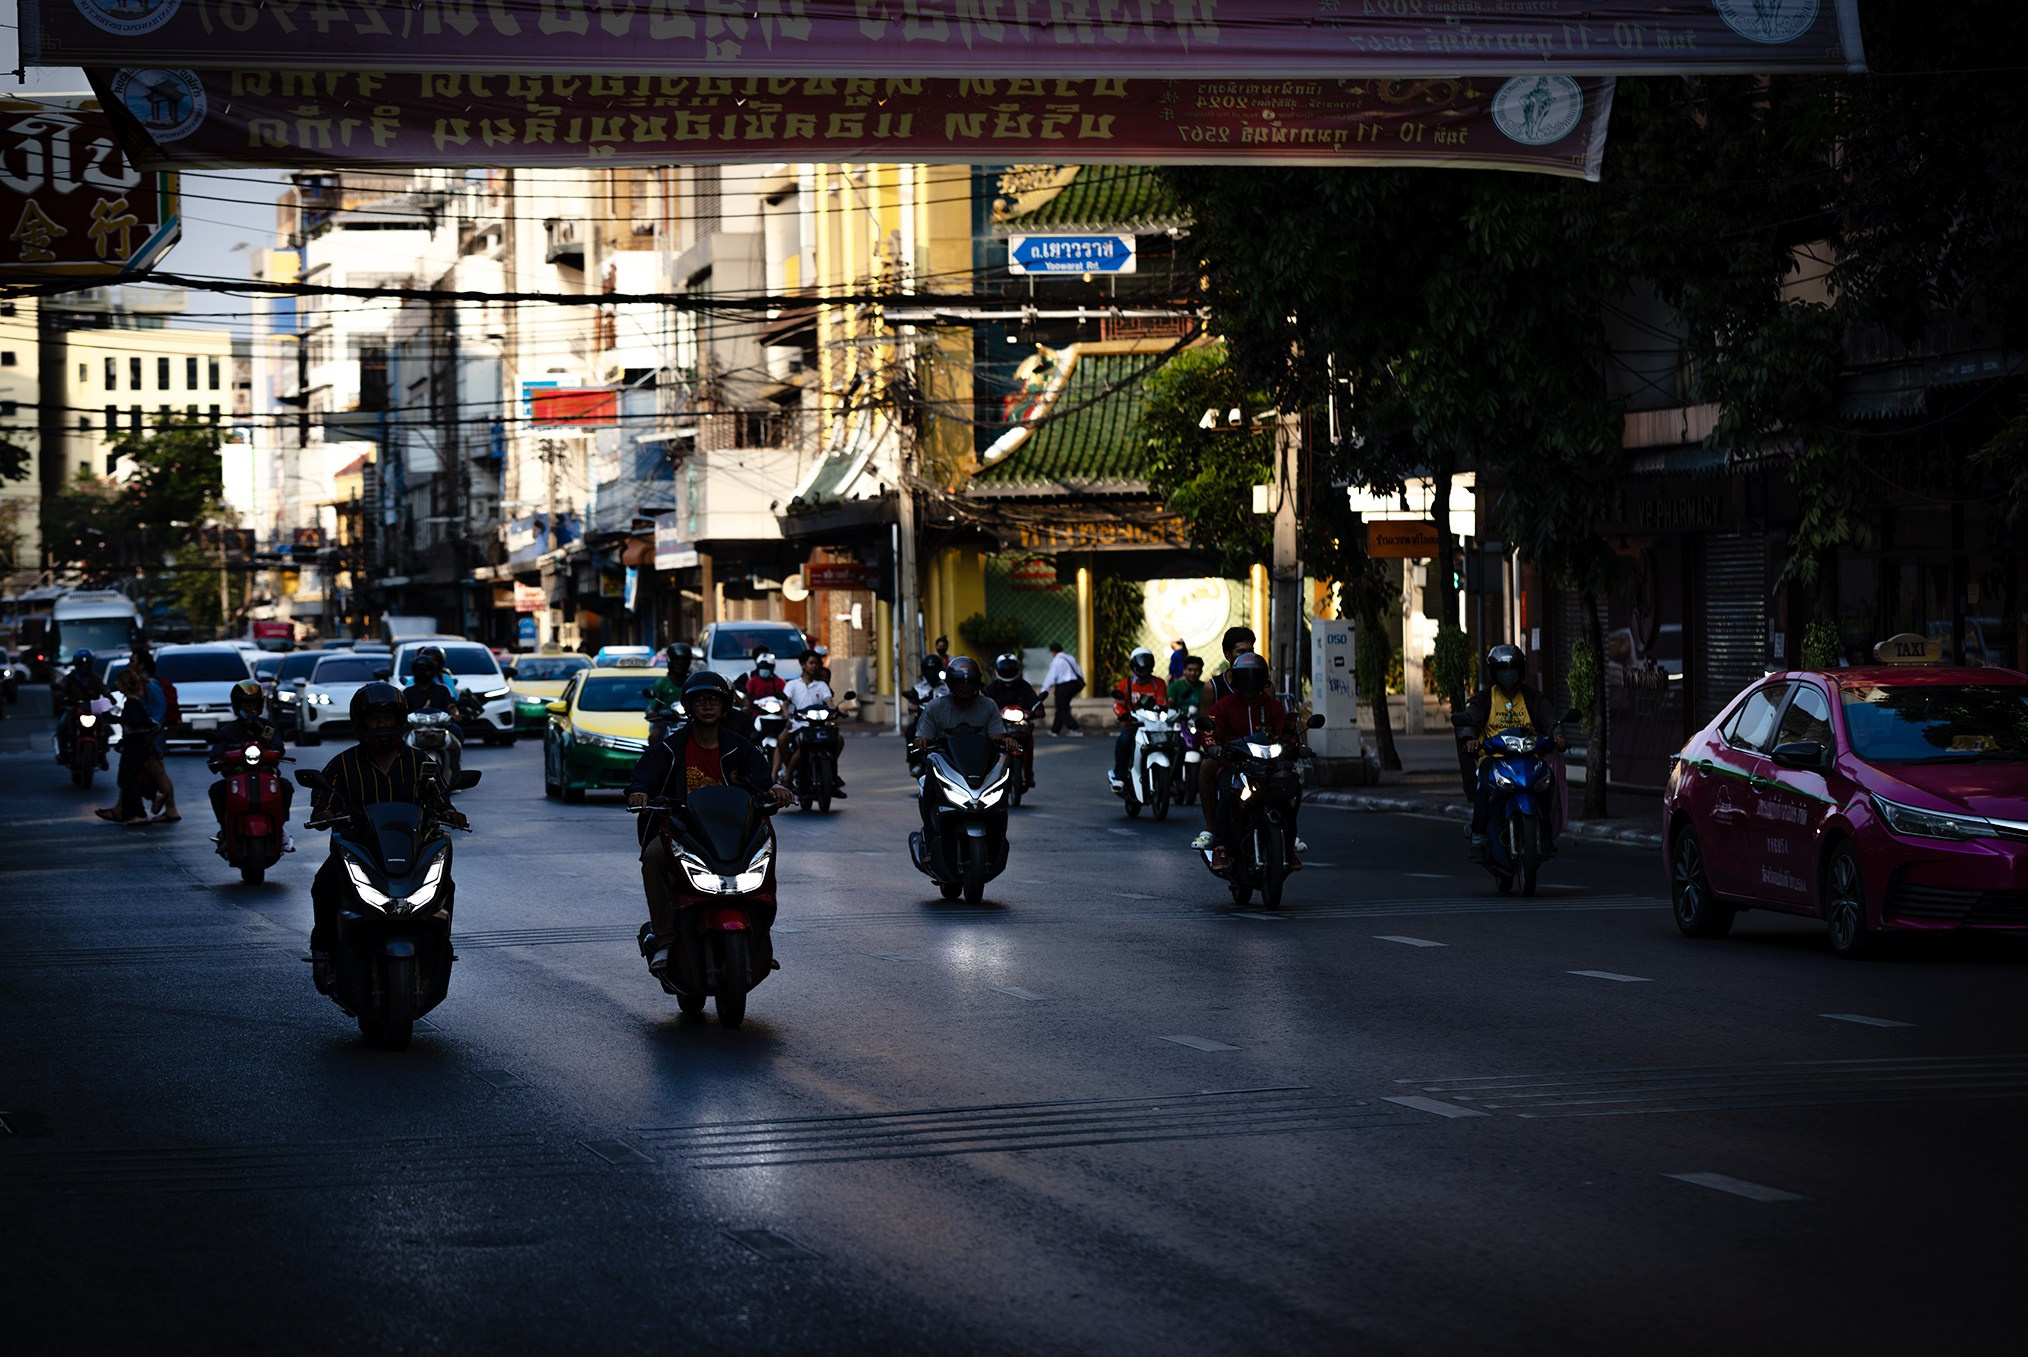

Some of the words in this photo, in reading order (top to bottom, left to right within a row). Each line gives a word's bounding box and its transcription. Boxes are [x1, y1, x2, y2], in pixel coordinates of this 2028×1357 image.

[1030, 240, 1114, 259] ถ.เยาวราช
[1045, 261, 1084, 270] Yaowarat
[1895, 641, 1926, 657] TAXI
